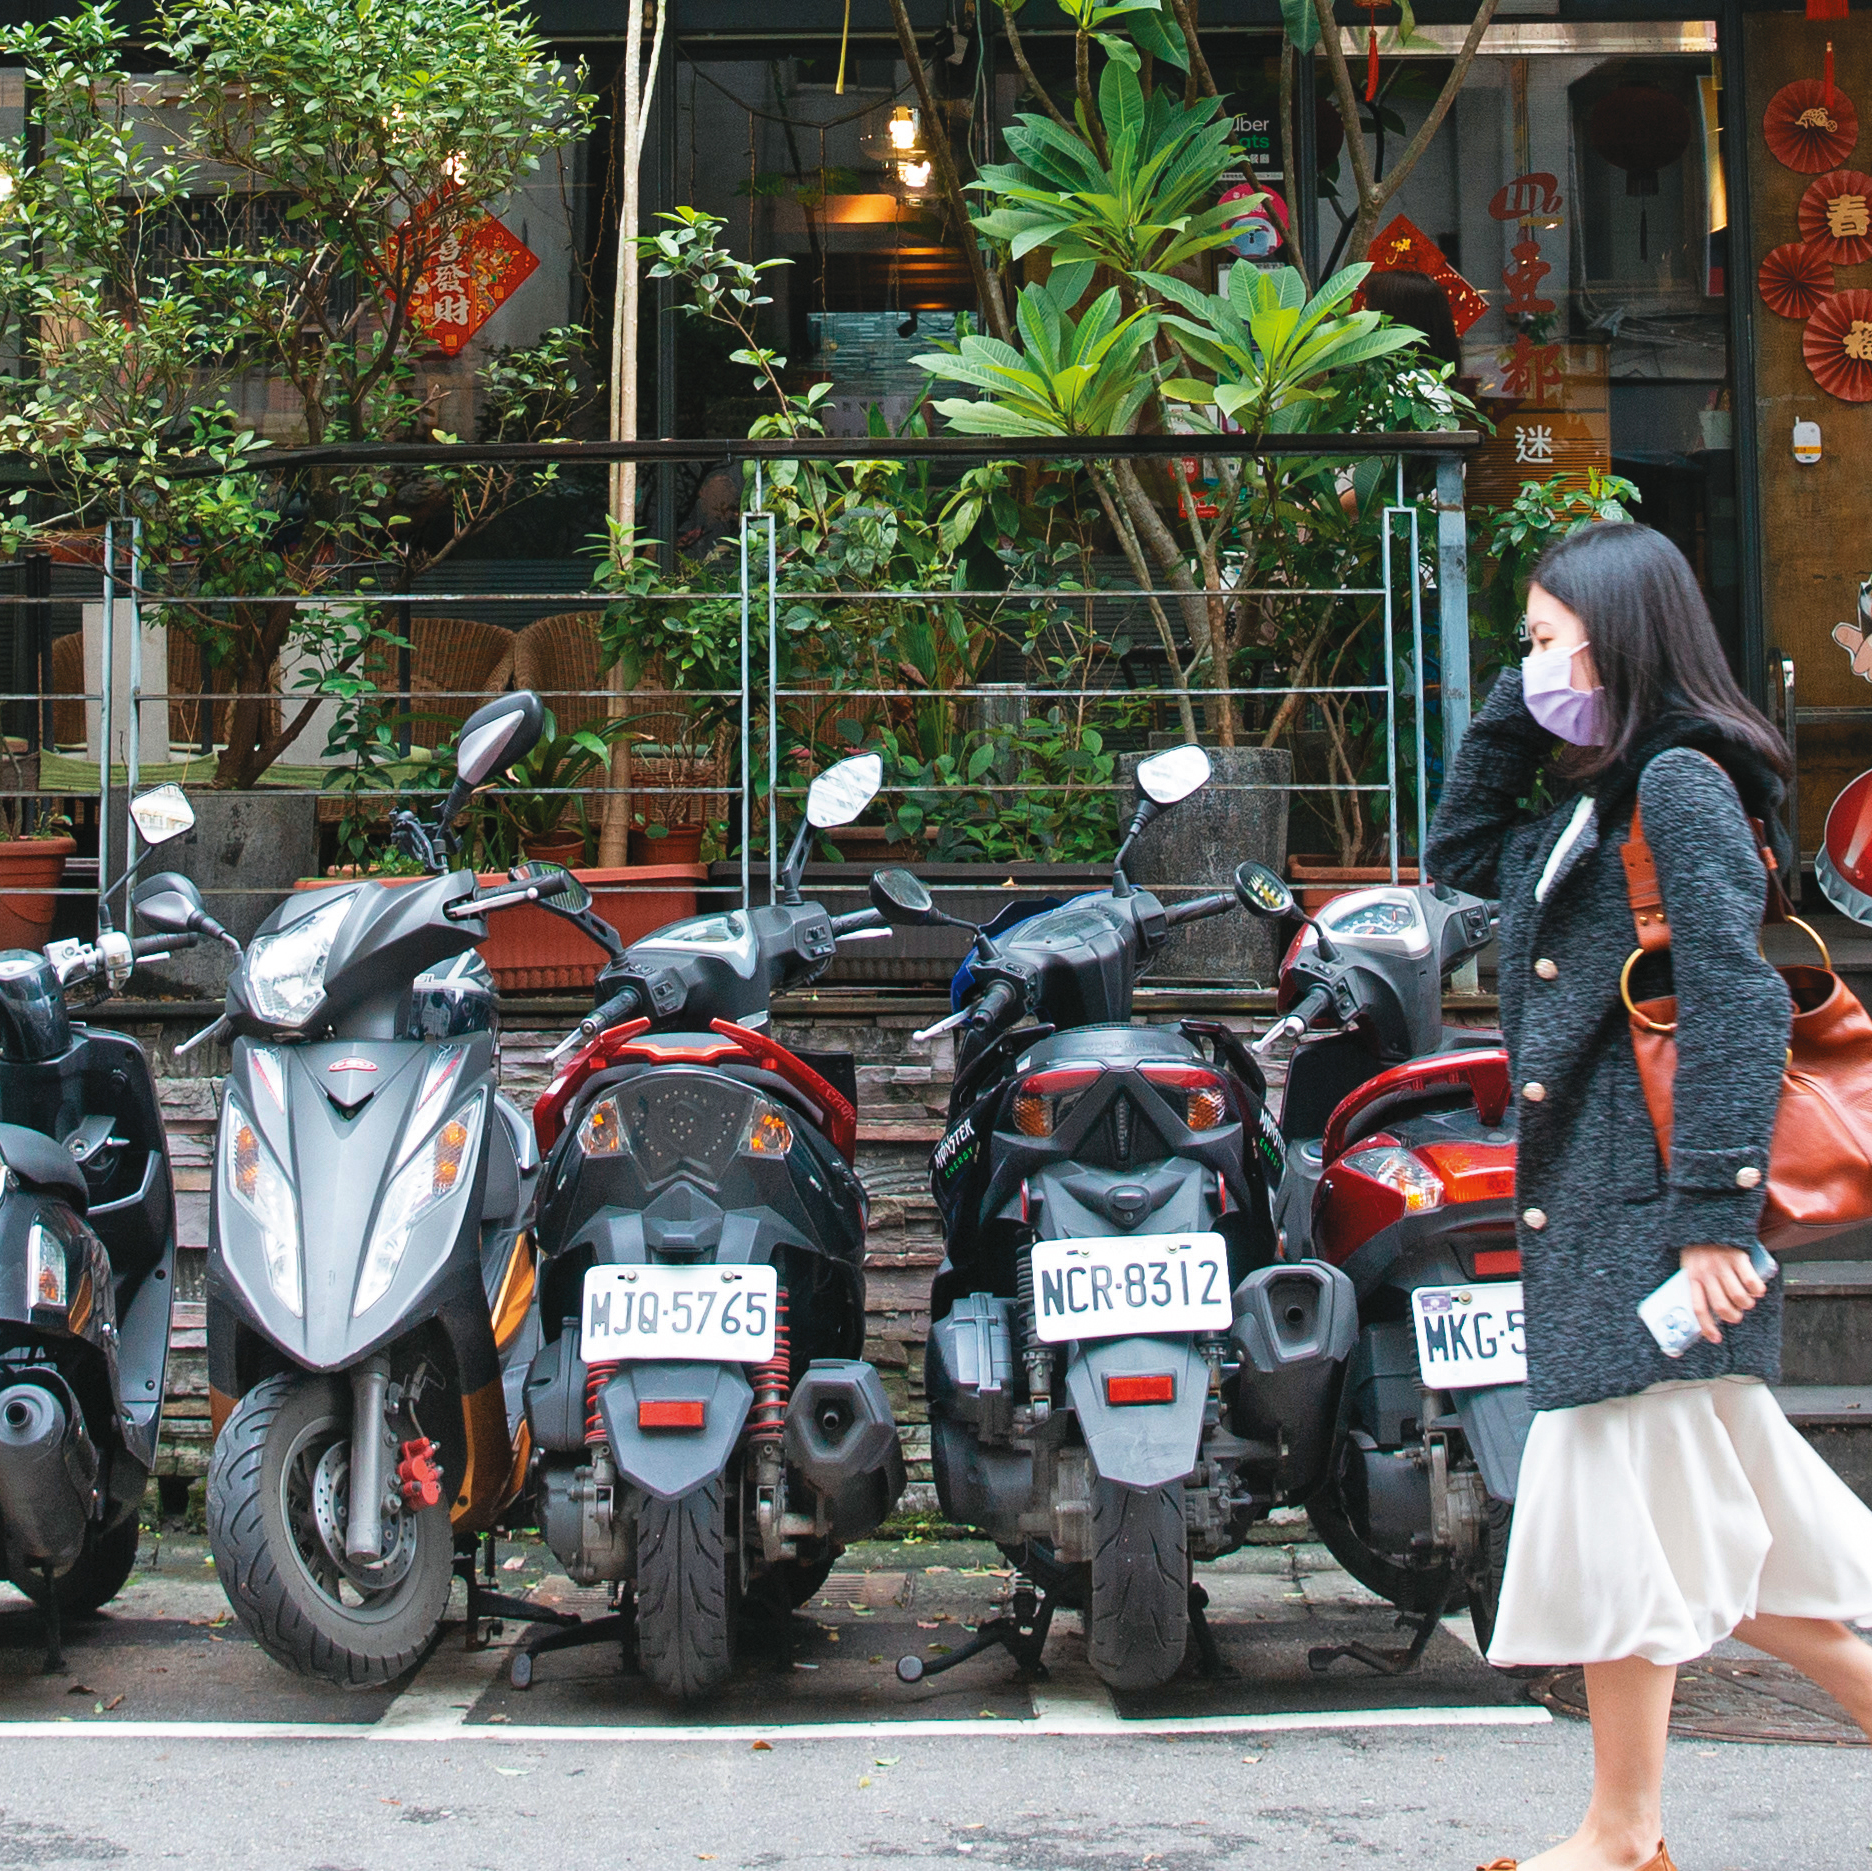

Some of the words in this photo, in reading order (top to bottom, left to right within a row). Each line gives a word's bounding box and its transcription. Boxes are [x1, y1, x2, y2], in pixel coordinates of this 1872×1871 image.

[1239, 134, 1270, 149] ats
[1826, 194, 1870, 238] 春
[934, 1117, 976, 1170] MONSTER
[944, 1146, 973, 1179] ENERGY
